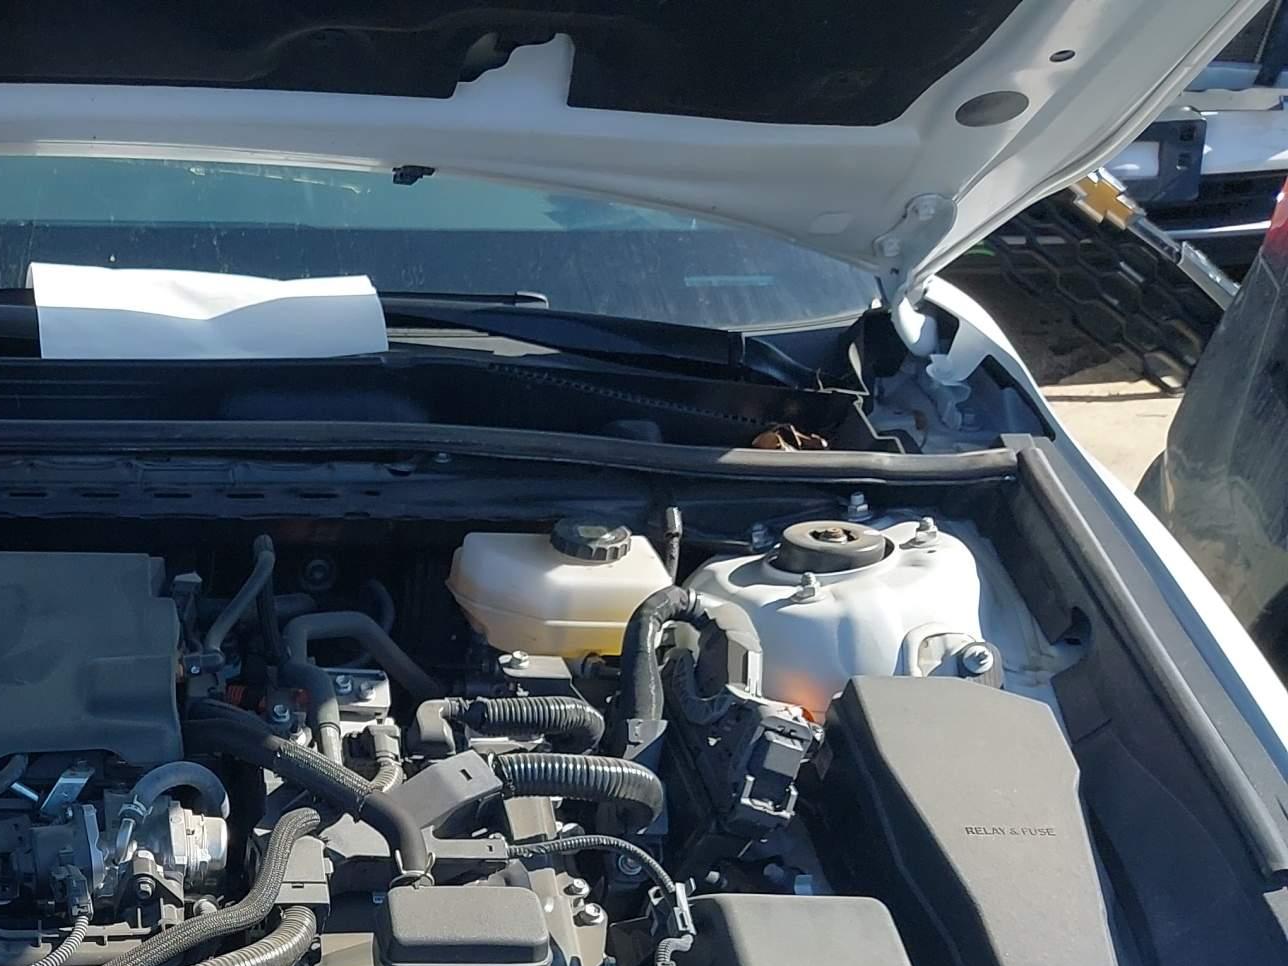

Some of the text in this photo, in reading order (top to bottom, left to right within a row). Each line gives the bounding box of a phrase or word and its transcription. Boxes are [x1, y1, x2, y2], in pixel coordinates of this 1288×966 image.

[964, 826, 1057, 837] RELAY & FUSE
